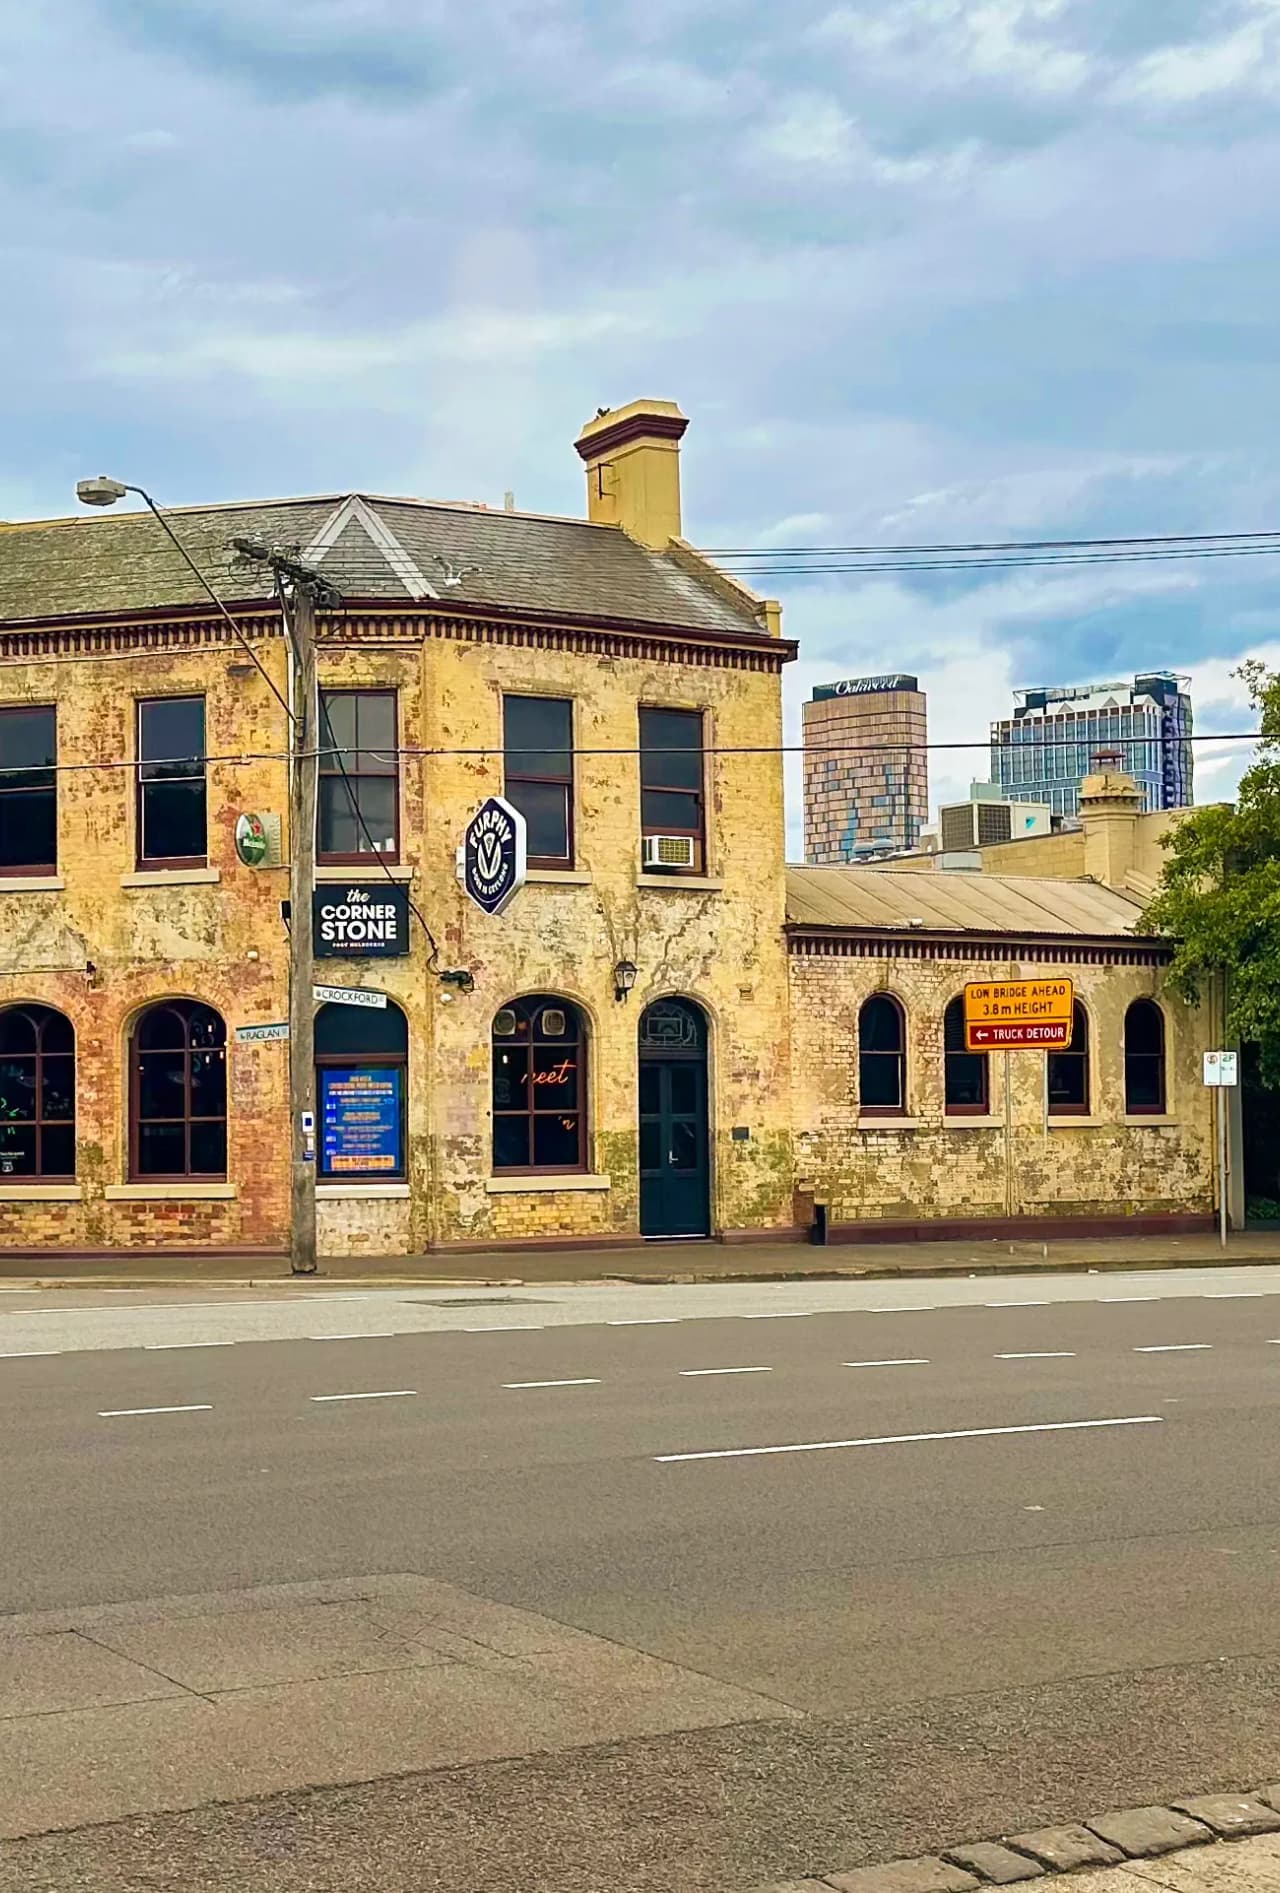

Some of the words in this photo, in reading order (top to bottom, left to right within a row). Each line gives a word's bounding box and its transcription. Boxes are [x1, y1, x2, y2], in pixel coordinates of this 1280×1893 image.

[469, 810, 512, 849] FURPHY
[346, 889, 370, 903] the
[320, 905, 397, 920] CORNER
[320, 921, 398, 941] STONE
[321, 989, 378, 1005] CROCKFORD
[970, 988, 990, 1000] LOW
[993, 986, 1027, 999] BRIDGE
[1031, 985, 1066, 997] AHEAD
[1014, 1001, 1053, 1014] HEIGHT
[246, 1029, 280, 1040] RAGLAN
[993, 1028, 1024, 1040] TRUCK
[1026, 1026, 1064, 1039] DETOUR
